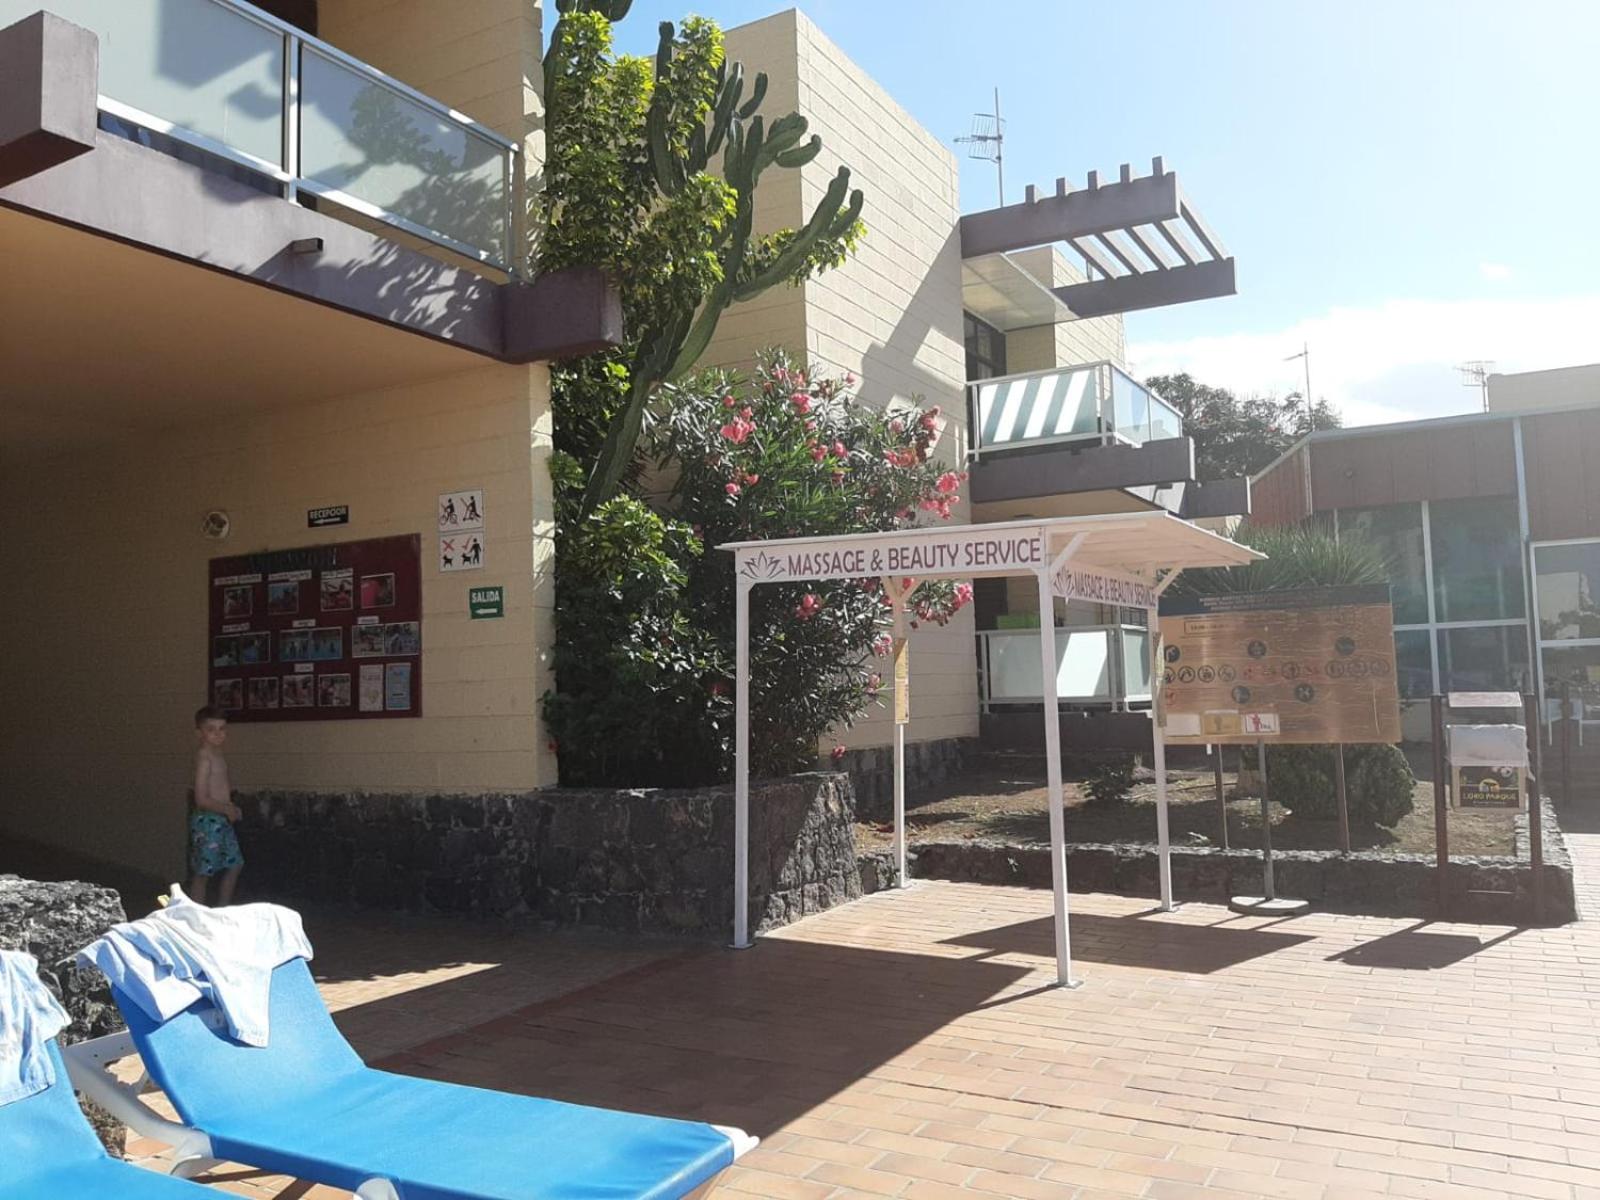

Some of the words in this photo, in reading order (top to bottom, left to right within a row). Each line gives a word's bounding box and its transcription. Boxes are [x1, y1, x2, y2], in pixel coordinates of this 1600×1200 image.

[788, 550, 865, 576] MASSAGE
[870, 549, 883, 572] &
[888, 543, 959, 571] BEAUTY
[964, 538, 1041, 566] SERVICE
[471, 590, 501, 604] SALIDA
[1074, 571, 1104, 599] MASSAGE
[1110, 578, 1134, 604] BEAUTY
[1134, 583, 1157, 607] SERVICE
